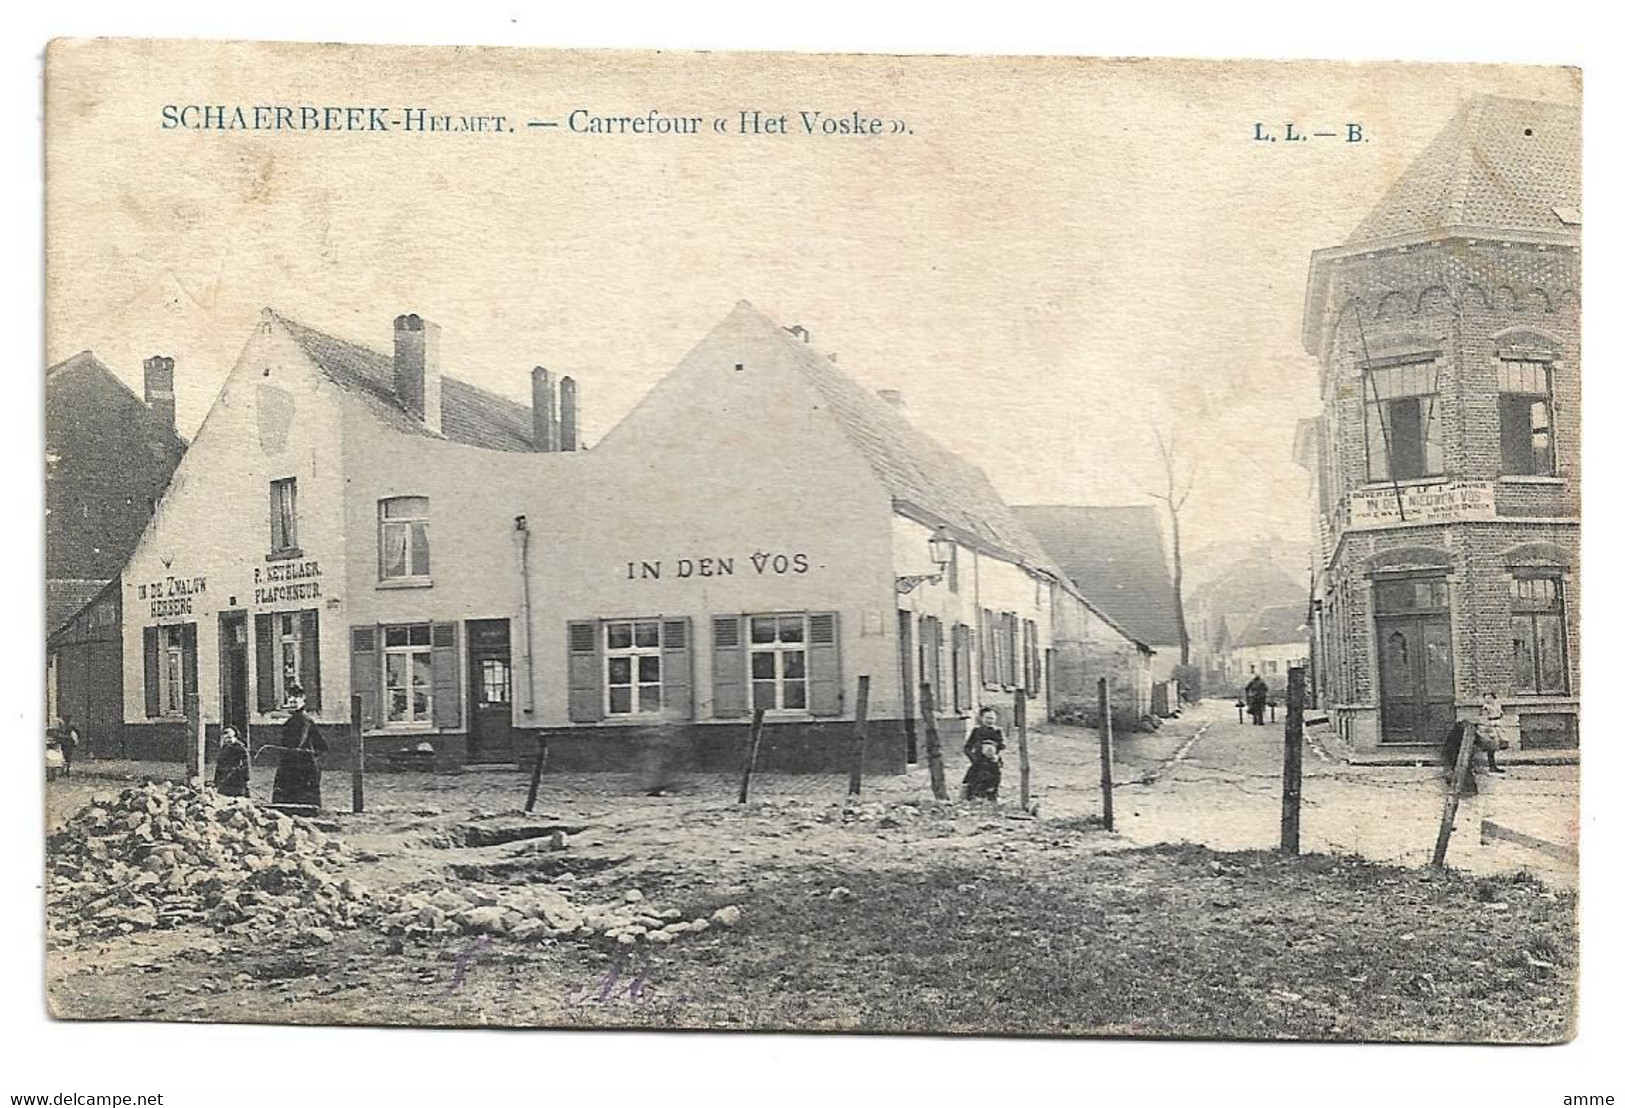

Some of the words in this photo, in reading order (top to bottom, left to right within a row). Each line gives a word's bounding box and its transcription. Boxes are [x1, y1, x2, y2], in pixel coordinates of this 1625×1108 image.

[568, 109, 702, 134] Carrefour
[739, 110, 787, 134] Het
[1253, 122, 1276, 142] L.
[1285, 123, 1307, 141] L.
[1345, 123, 1369, 143] B.
[1461, 491, 1482, 503] VOS
[627, 562, 661, 580] IN
[677, 558, 734, 578] DEN
[750, 552, 809, 575] VOS
[150, 583, 163, 599] DE
[150, 597, 192, 618] HERBERG
